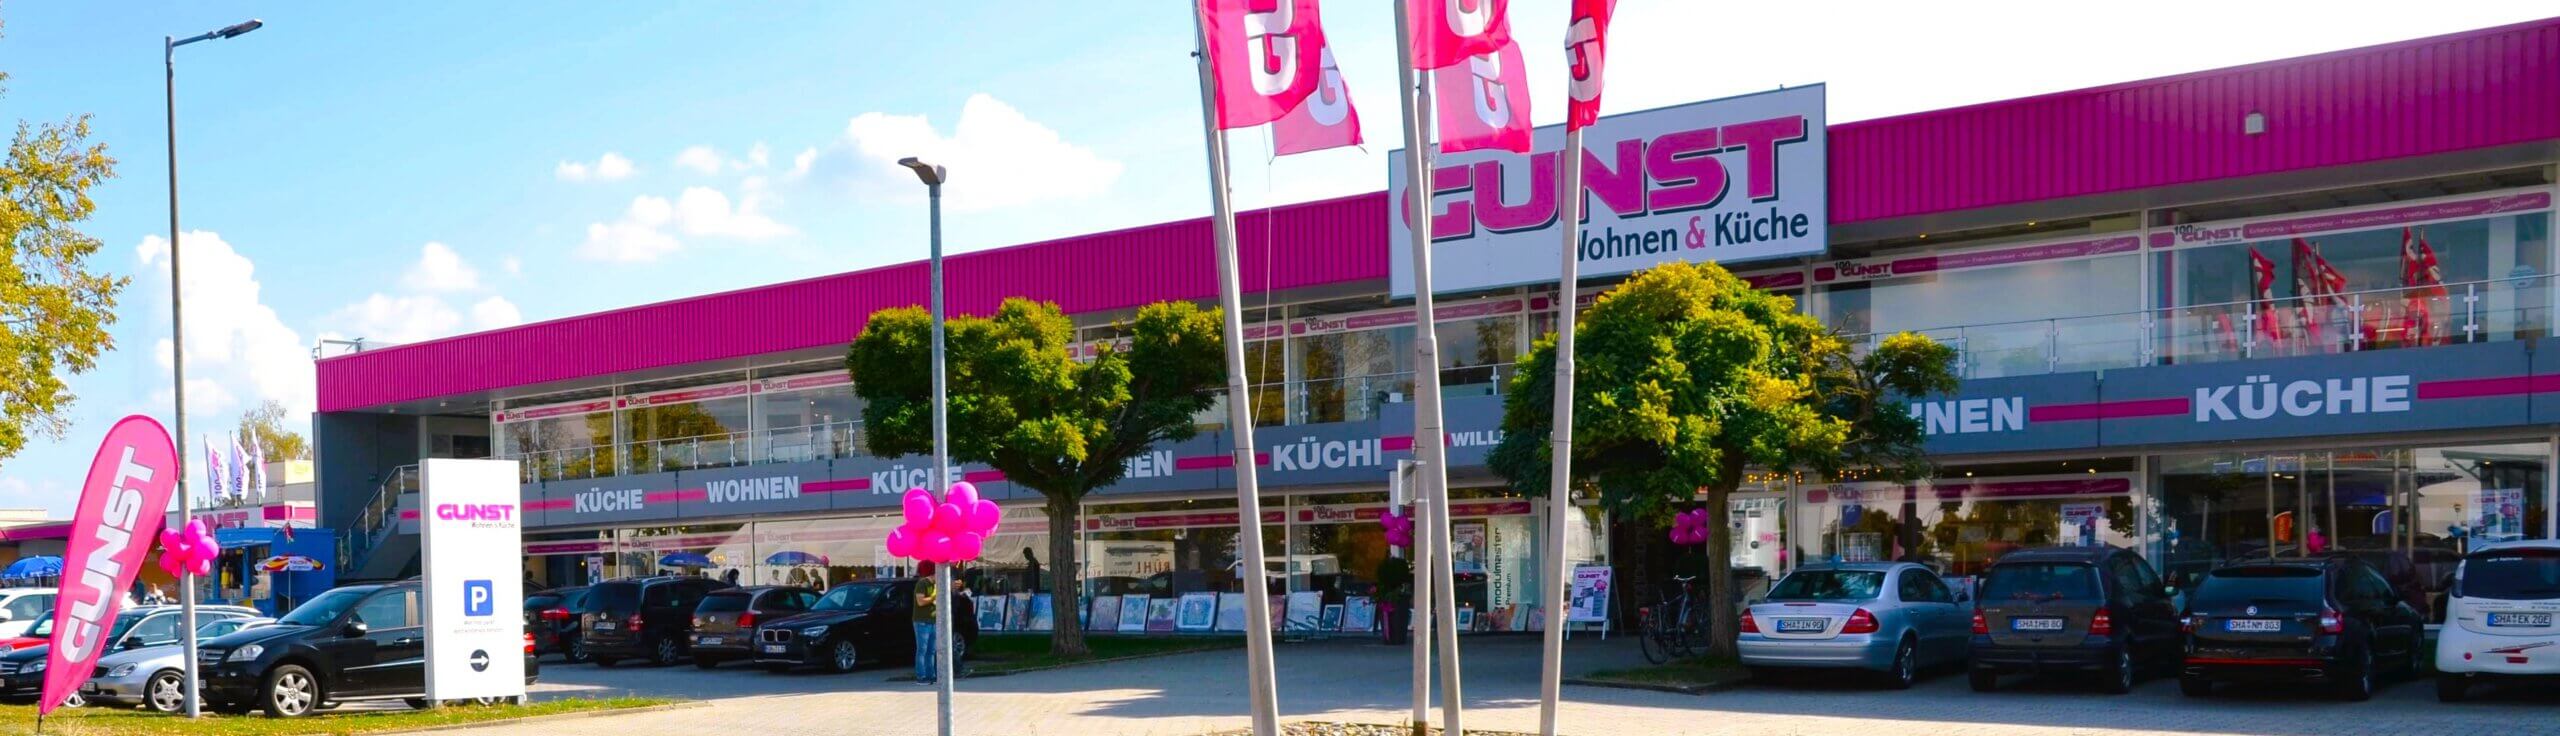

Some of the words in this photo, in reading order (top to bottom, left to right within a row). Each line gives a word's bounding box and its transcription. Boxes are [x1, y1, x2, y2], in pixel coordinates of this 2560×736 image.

[1401, 115, 1808, 243] GUNST
[1685, 215, 1706, 250] &
[1715, 206, 1809, 247] Küche
[2181, 227, 2242, 243] GUNST
[1841, 262, 1892, 278] GUNST
[1309, 318, 1346, 332] GUNST
[2195, 374, 2411, 423] KÜCHE
[1907, 396, 2023, 436] NEN
[1450, 429, 1505, 448] WILL
[574, 487, 644, 514] KÜCHE
[706, 475, 800, 504] WOHNEN
[436, 503, 516, 521] GUNST
[61, 445, 154, 664] GUNST
[470, 586, 488, 612] P
[2494, 614, 2512, 624] SHA
[2518, 614, 2532, 624] EK
